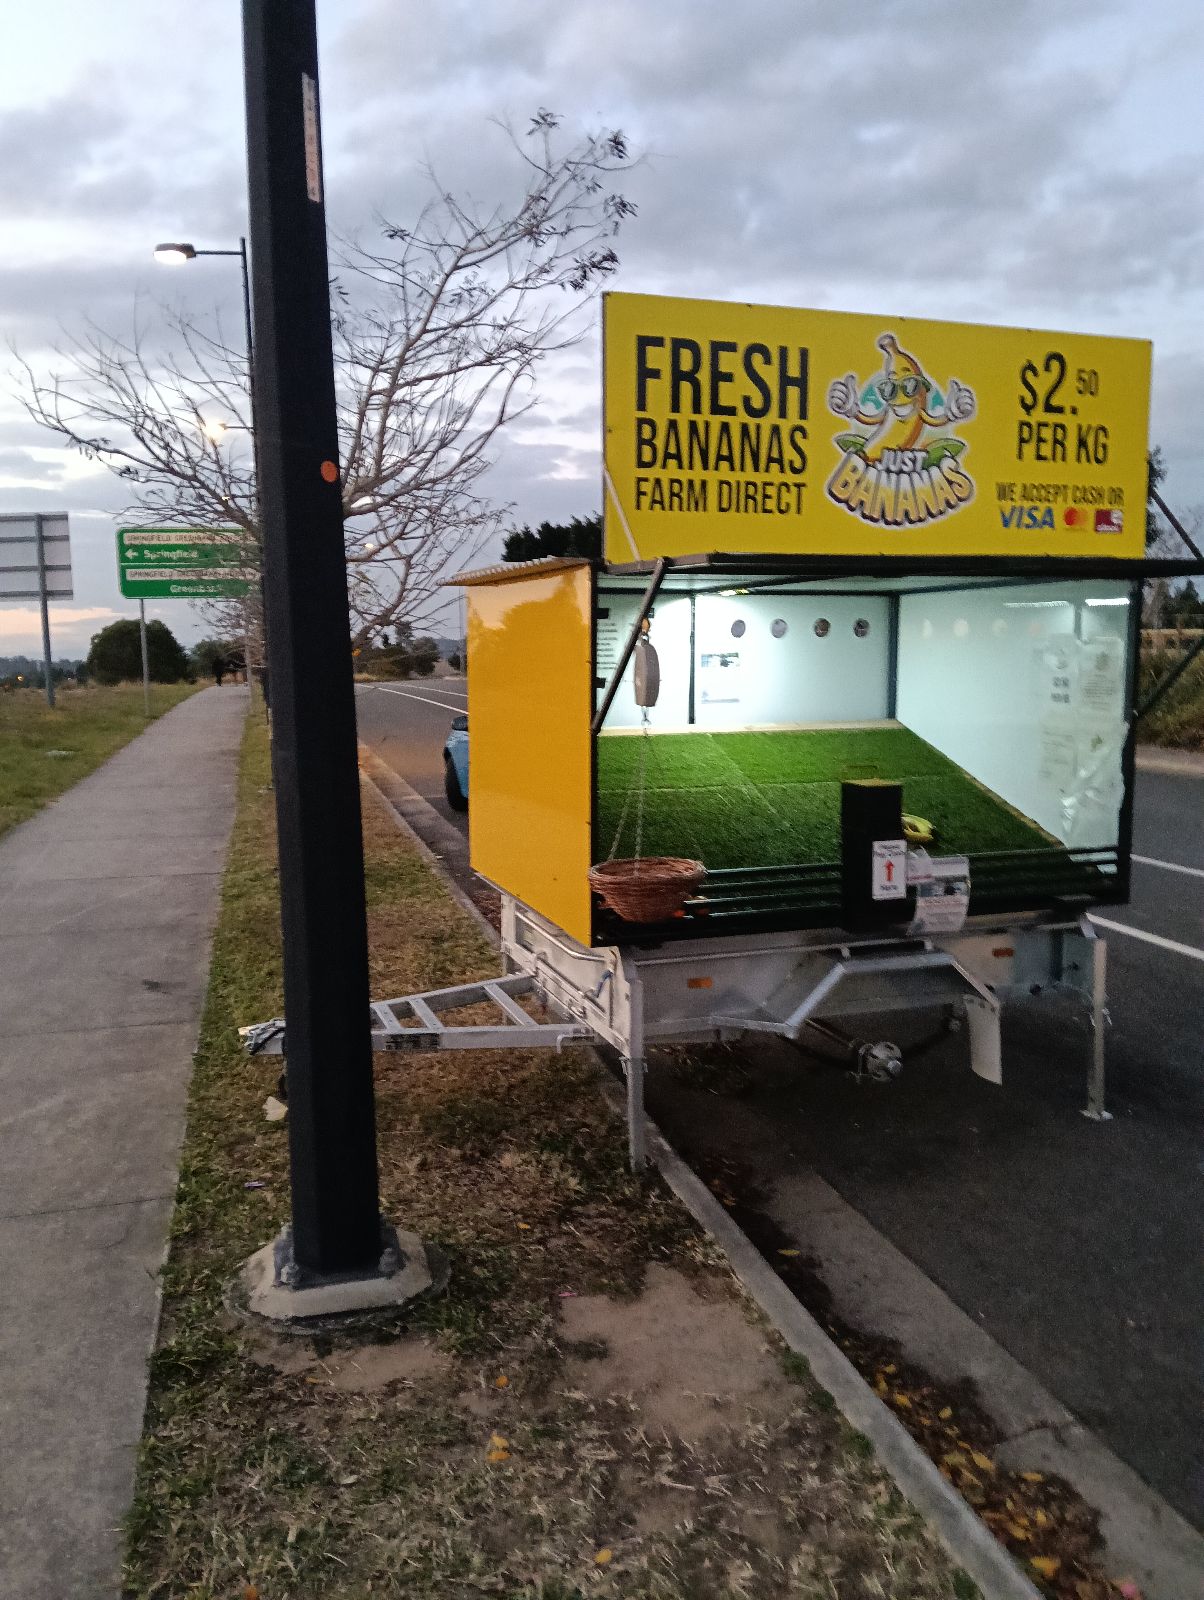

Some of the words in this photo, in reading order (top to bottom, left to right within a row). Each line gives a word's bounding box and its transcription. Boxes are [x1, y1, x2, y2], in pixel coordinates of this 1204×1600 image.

[636, 335, 809, 420] FRESH
[635, 417, 808, 475] BANANAS
[875, 449, 929, 472] JUST
[1016, 419, 1067, 463] PER
[1076, 423, 1109, 465] KG
[635, 476, 708, 513] FARM
[718, 480, 807, 516] DIRECT
[827, 454, 974, 526] BANANAS
[996, 482, 1016, 502] WE
[1021, 483, 1069, 504] ACCEPT
[1071, 485, 1106, 505] CASH
[1107, 486, 1125, 507] OR
[999, 505, 1056, 531] VISA
